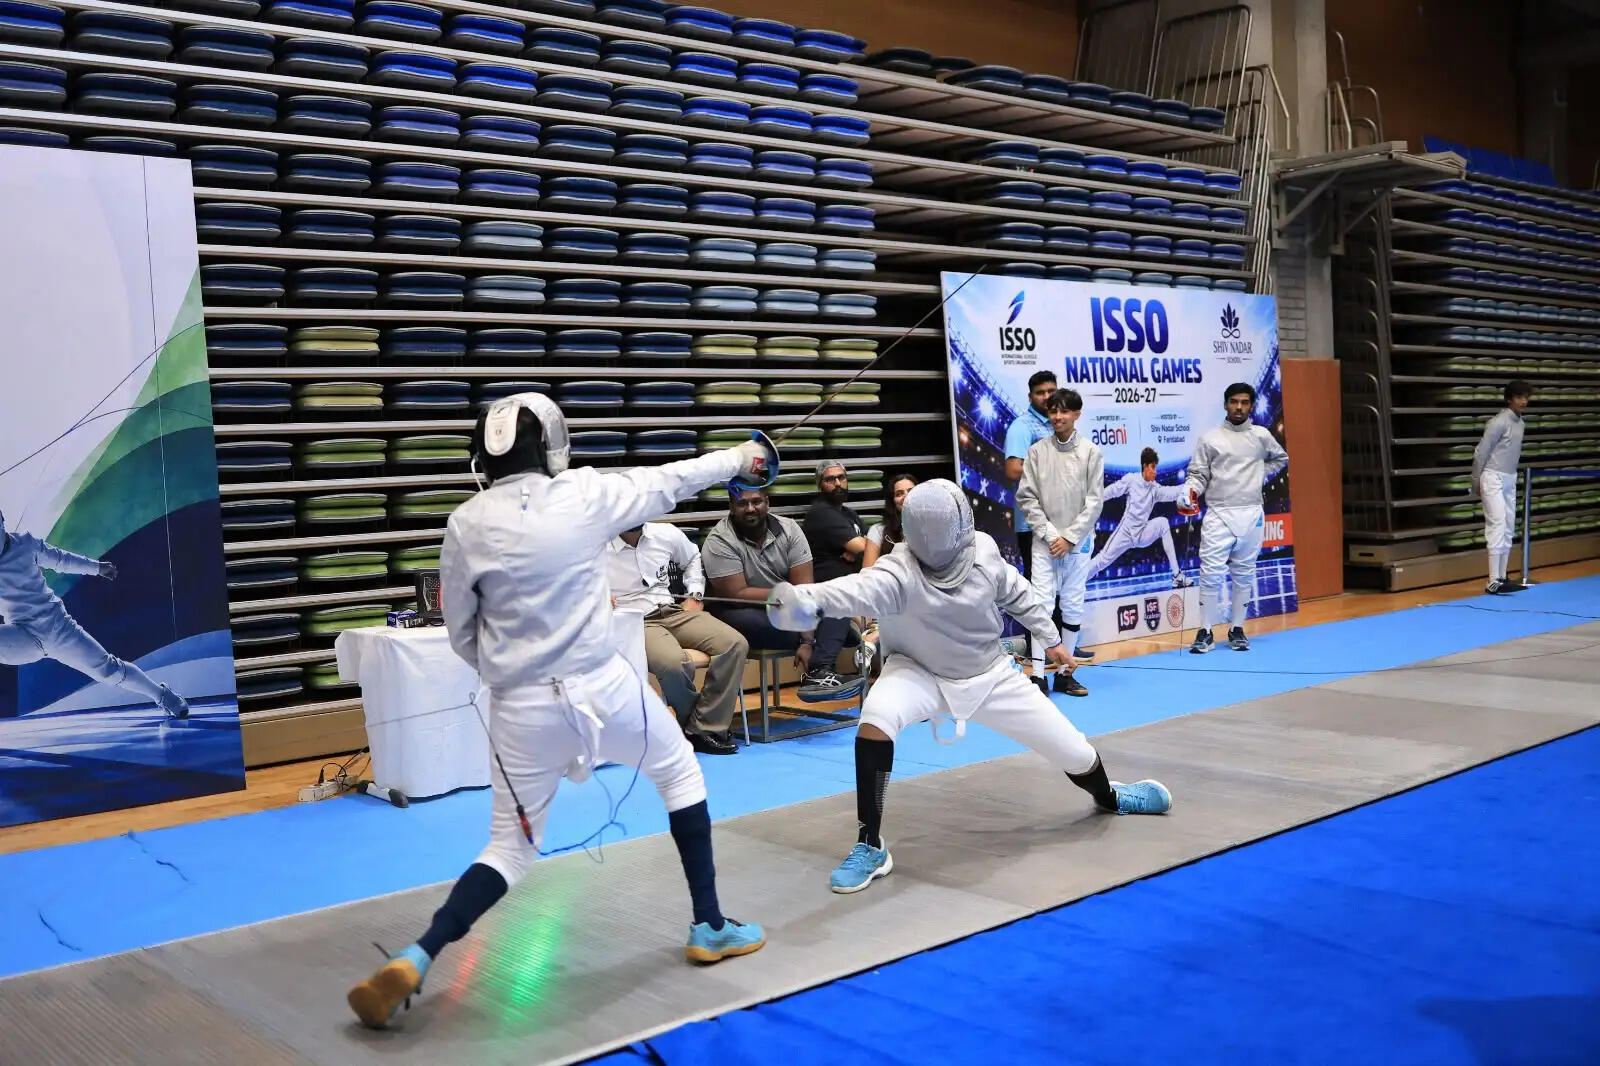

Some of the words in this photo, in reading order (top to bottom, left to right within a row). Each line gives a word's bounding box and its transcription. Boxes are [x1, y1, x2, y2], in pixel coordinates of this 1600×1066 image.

[1090, 297, 1169, 354] ISSO
[1000, 327, 1036, 351] ISSO
[1213, 341, 1228, 353] SHIV
[1230, 341, 1253, 354] NADAR
[1065, 356, 1149, 384] NATIONAL
[1151, 357, 1203, 384] GAMES
[1114, 388, 1157, 403] 2026-27
[1092, 424, 1127, 445] adani
[1150, 424, 1160, 432] Shiv
[1161, 424, 1175, 432] Nadar
[1263, 519, 1284, 541] ING
[1146, 601, 1158, 612] ISF
[1121, 609, 1136, 626] ISF
